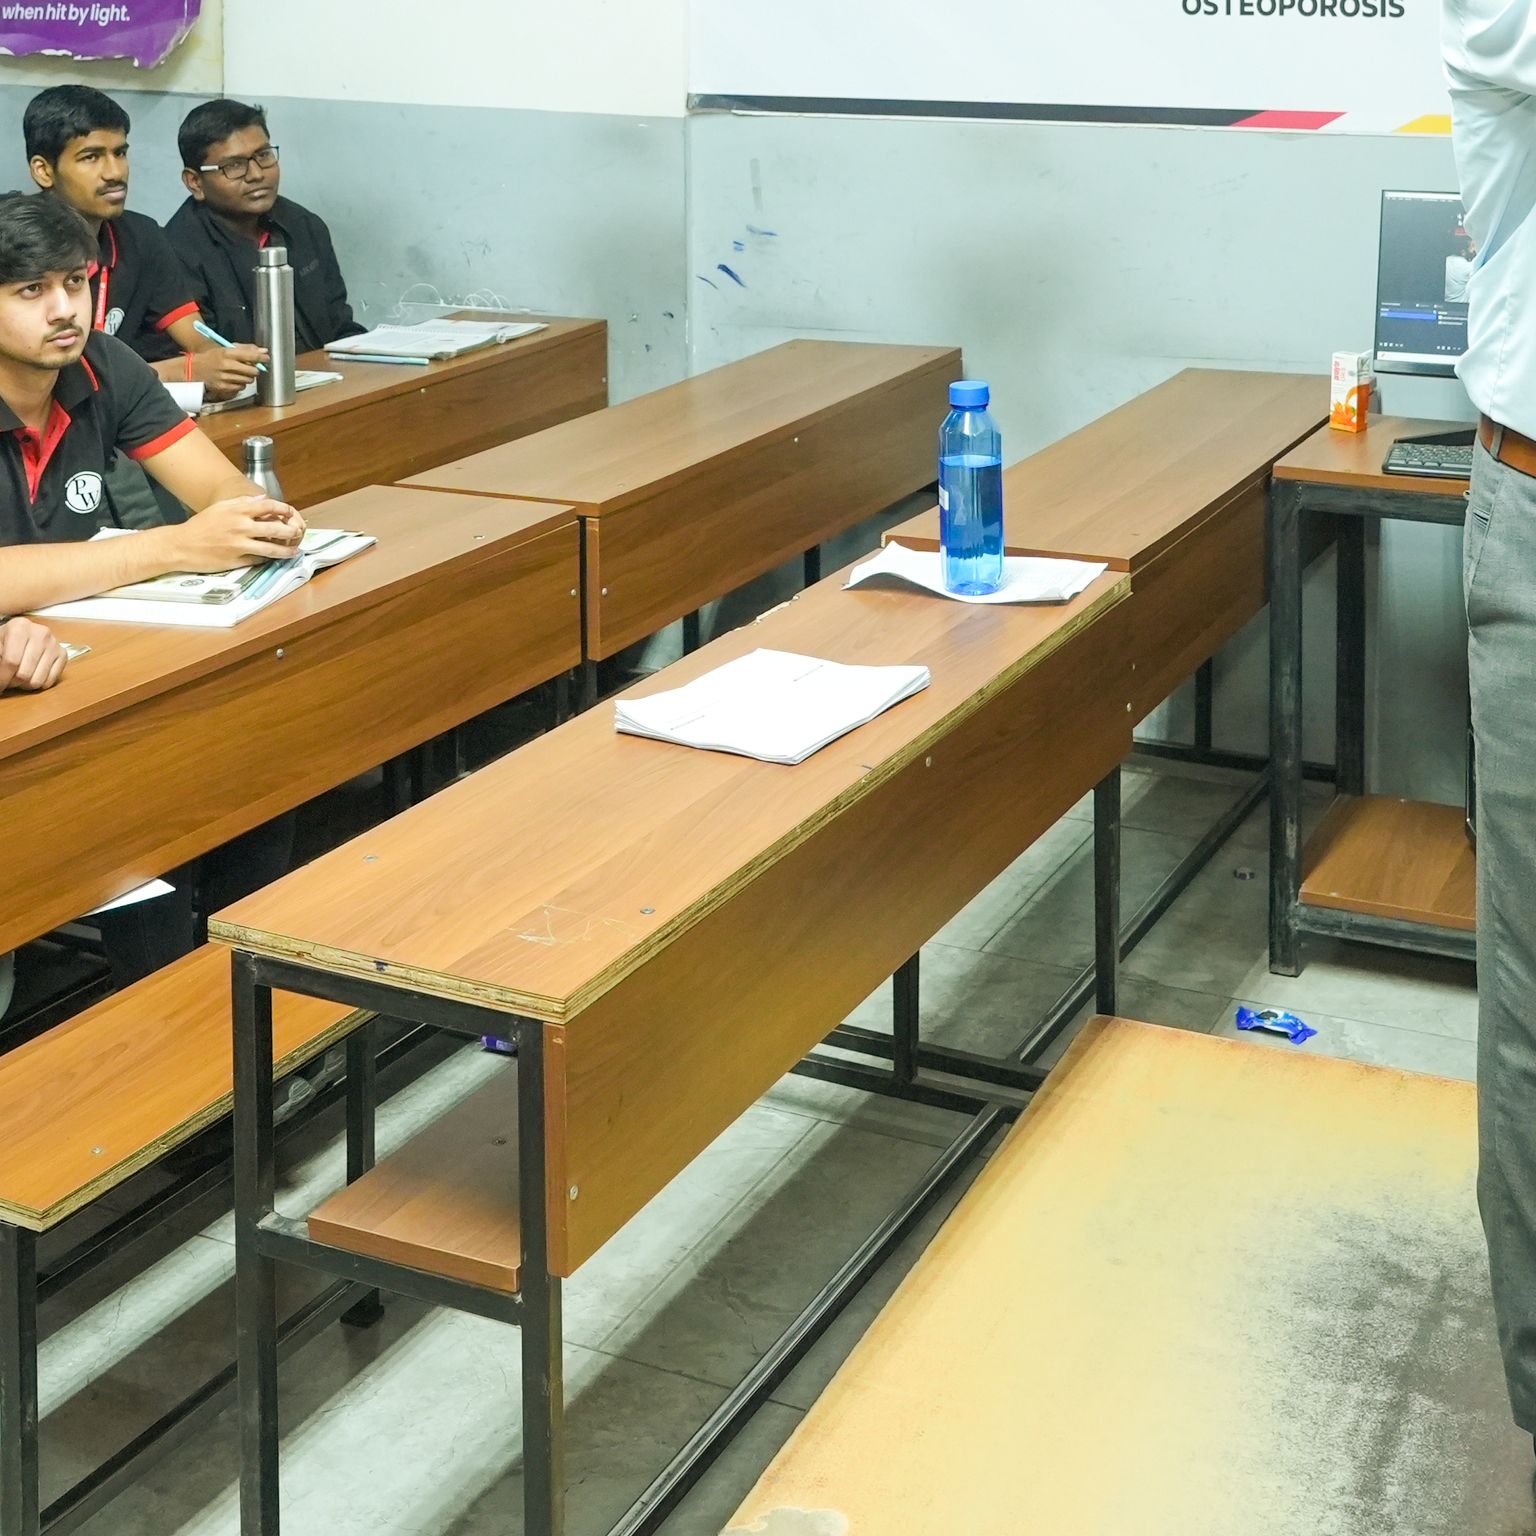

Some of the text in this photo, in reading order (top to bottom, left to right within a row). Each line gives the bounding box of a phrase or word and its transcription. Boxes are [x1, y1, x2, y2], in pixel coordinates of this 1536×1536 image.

[2, 3, 45, 20] when
[45, 3, 67, 21] hit
[68, 4, 89, 26] by
[90, 3, 131, 27] light.
